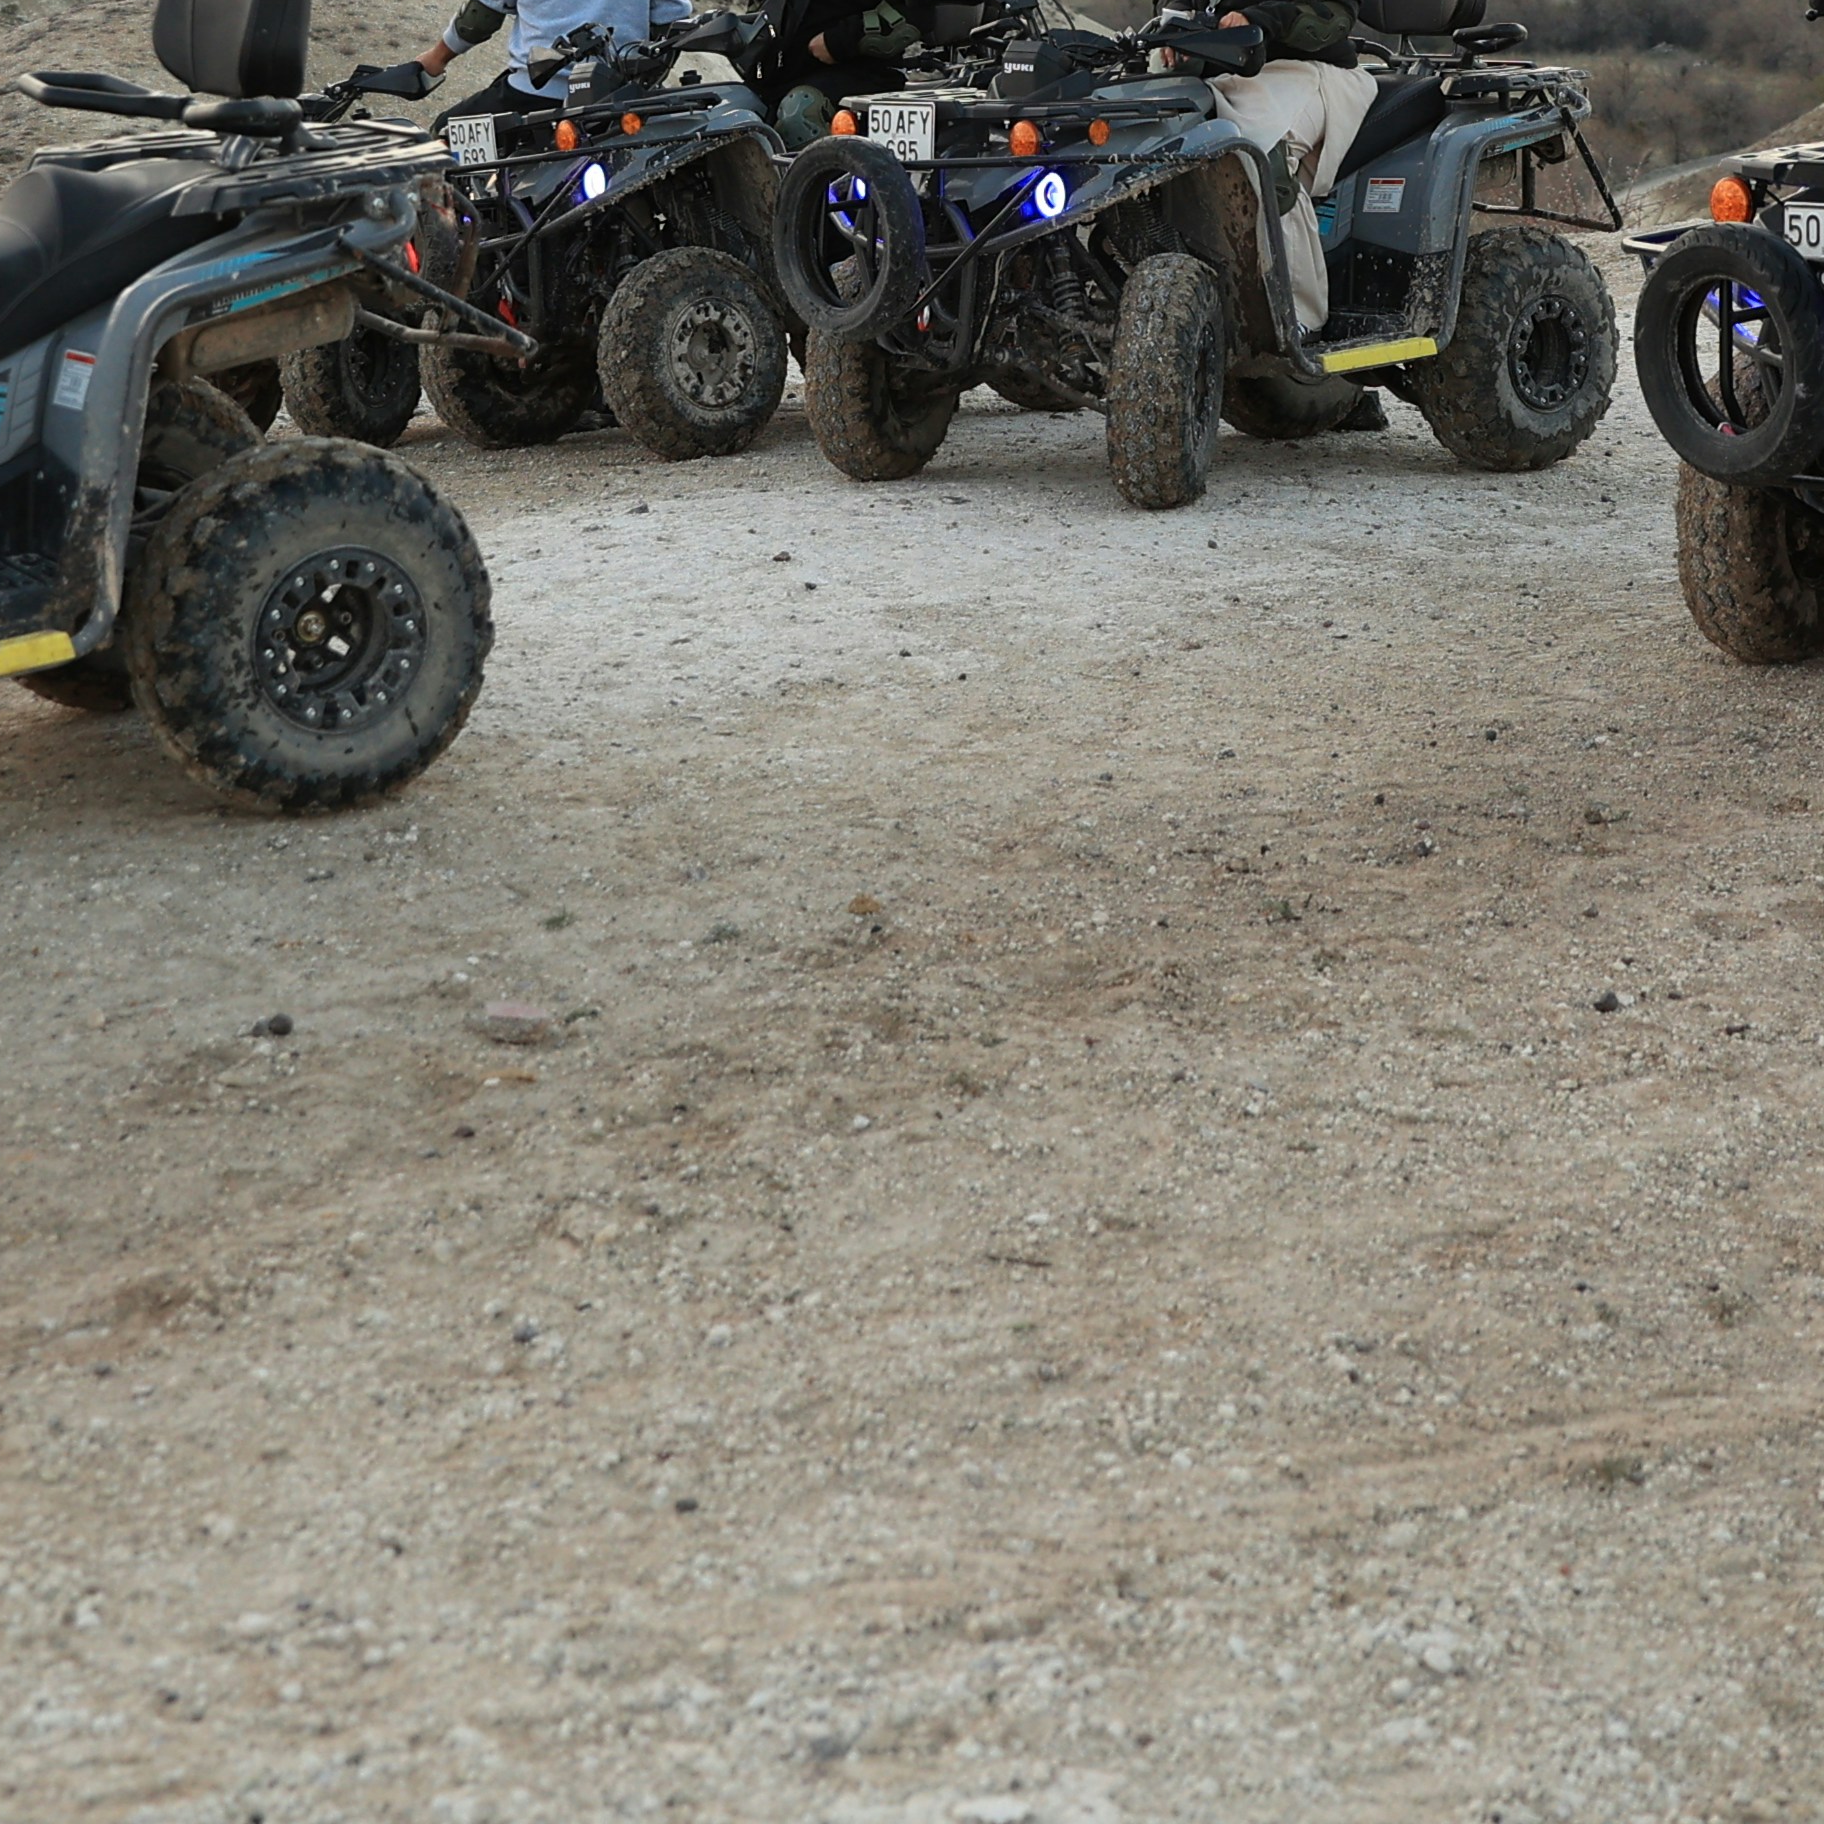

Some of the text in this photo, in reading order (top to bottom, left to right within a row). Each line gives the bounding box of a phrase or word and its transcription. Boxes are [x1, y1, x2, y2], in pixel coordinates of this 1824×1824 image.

[450, 122, 491, 145] 50 AFY
[871, 110, 930, 135] 50 AFY
[886, 140, 918, 160] 695
[1788, 214, 1821, 247] 50
